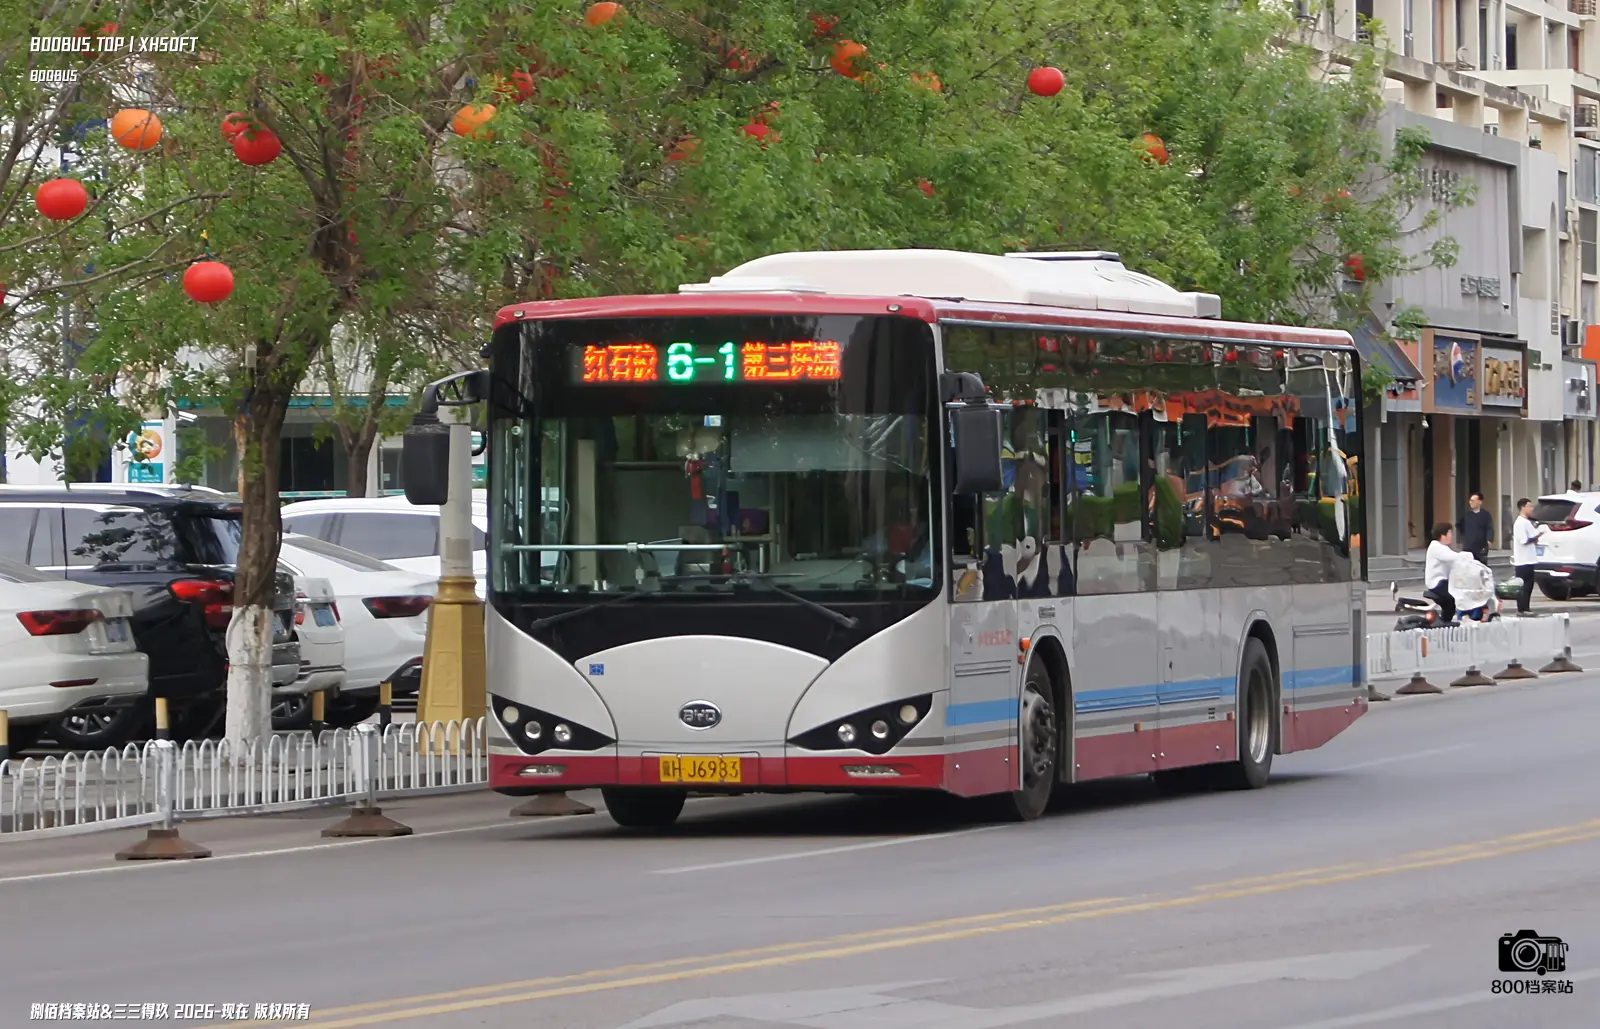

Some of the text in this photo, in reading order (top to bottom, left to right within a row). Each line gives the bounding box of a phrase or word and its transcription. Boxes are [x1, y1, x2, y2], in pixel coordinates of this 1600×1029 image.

[666, 341, 737, 383] 6-1
[741, 341, 842, 381] 第三医院
[683, 708, 717, 722] BYD
